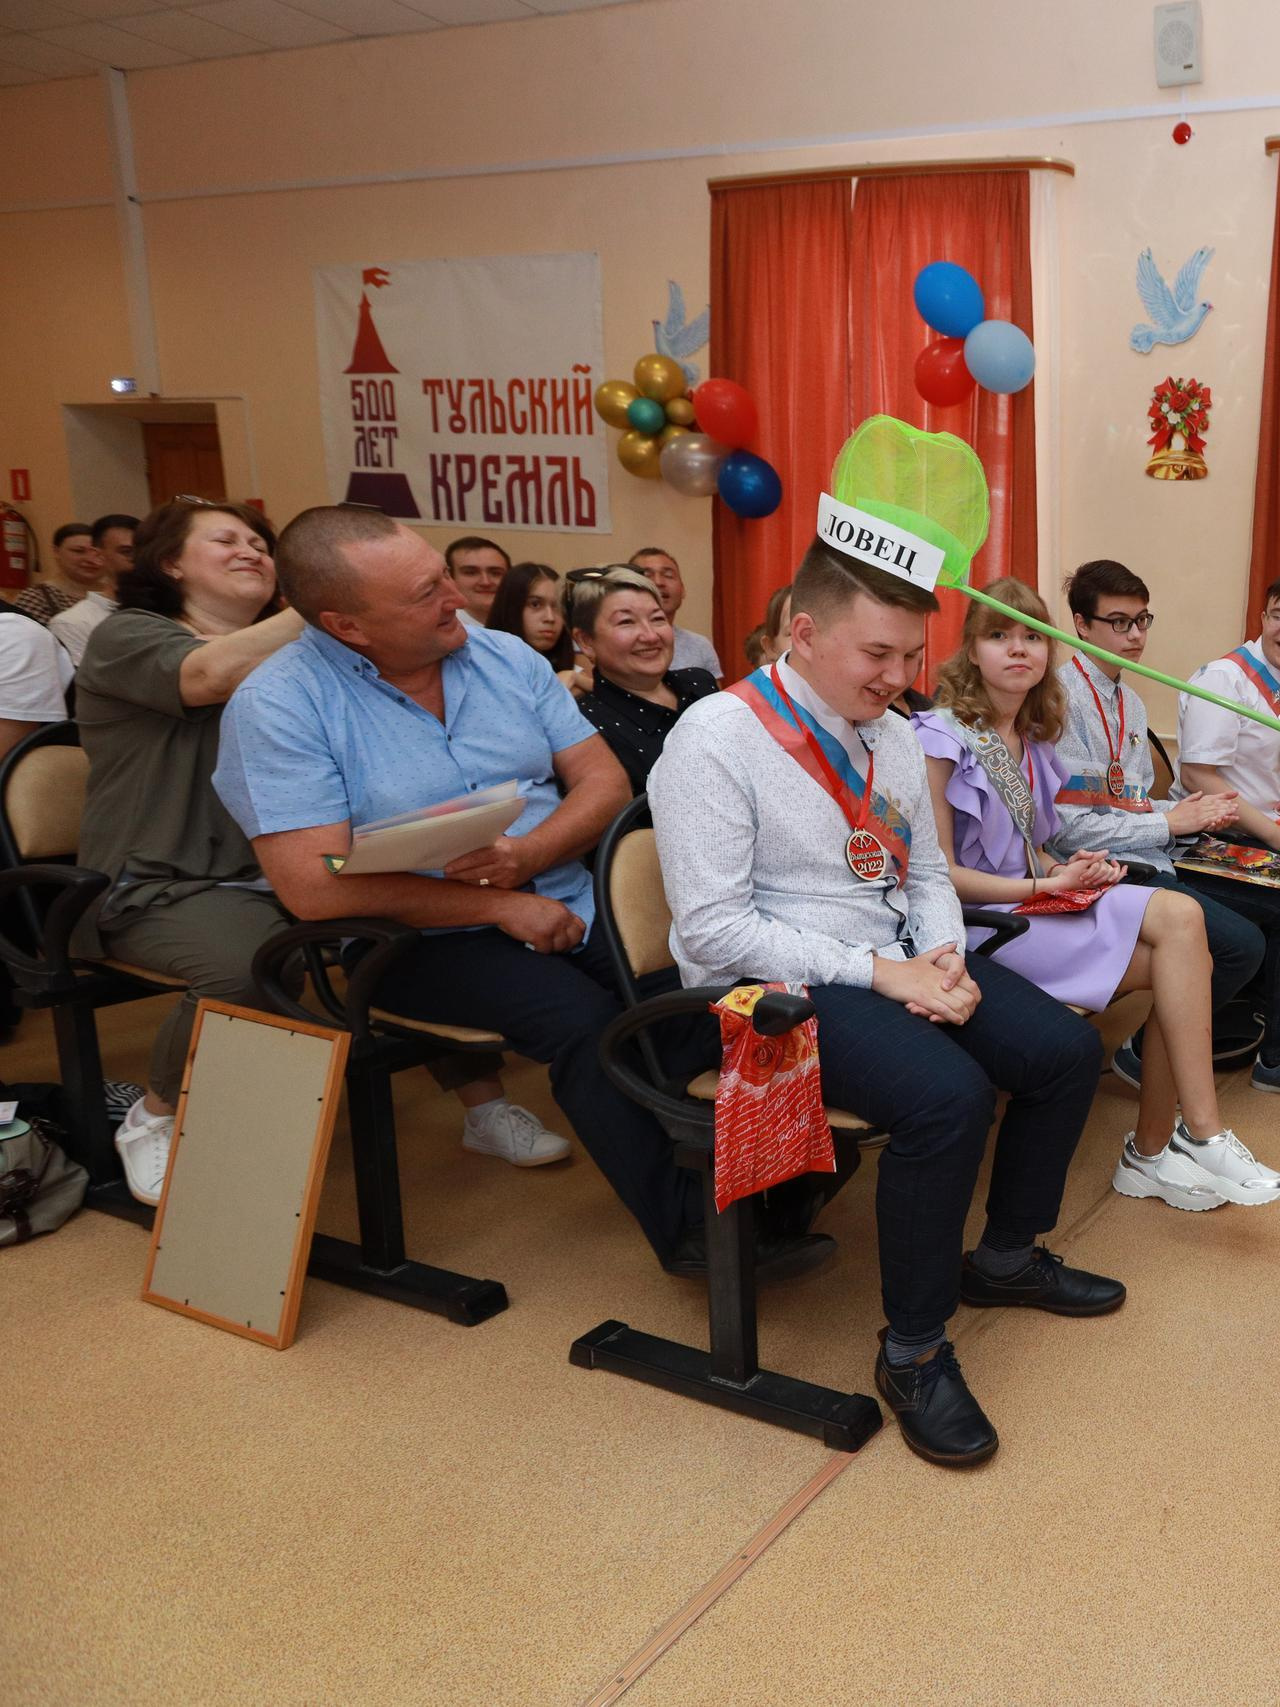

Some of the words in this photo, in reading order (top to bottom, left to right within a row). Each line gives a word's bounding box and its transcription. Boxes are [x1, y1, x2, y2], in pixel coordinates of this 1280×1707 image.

[351, 379, 397, 422] 500
[422, 363, 594, 436] ТУЛЬСКИЙ
[354, 426, 399, 468] ЛЕТ
[429, 453, 597, 527] КРЕМЛЬ
[823, 513, 918, 577] ЛОВЕЦ
[857, 859, 884, 874] 2022
